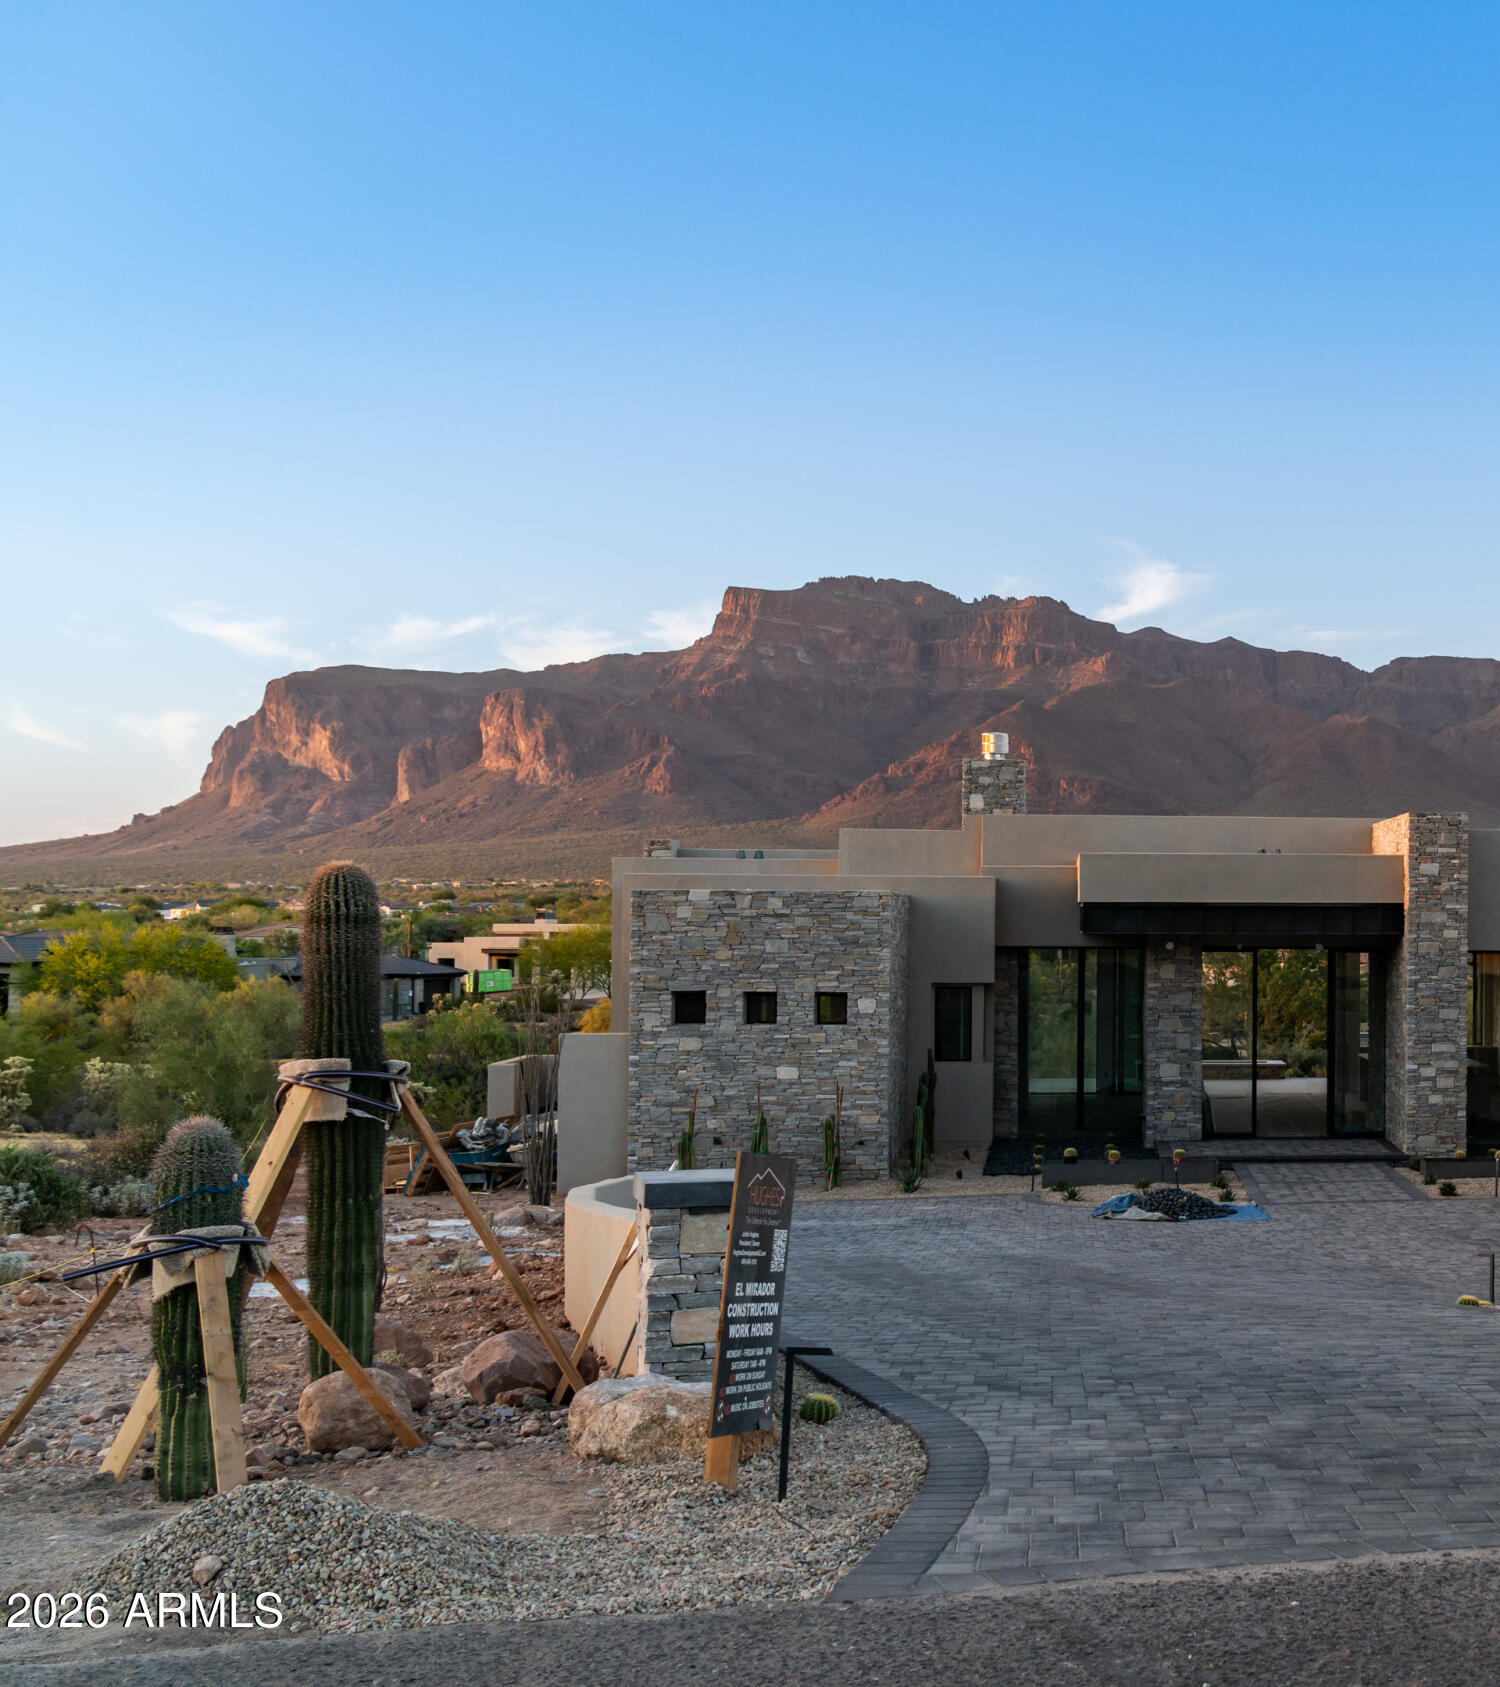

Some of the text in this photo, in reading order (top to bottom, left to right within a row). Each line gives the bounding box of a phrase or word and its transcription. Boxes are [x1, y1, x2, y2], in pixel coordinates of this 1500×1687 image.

[750, 1184, 780, 1206] HUGHES
[735, 1282, 776, 1296] EL MIRADOR
[727, 1302, 779, 1318] CONSTRUCTION
[729, 1322, 774, 1338] WORK HOURS
[726, 1349, 742, 1358] MONDAY
[744, 1348, 757, 1357] FRIDAY
[731, 1360, 750, 1370] SATURDAY
[735, 1372, 747, 1382] WORK
[752, 1370, 767, 1380] SUNDAY
[725, 1385, 737, 1395] WORK
[743, 1382, 756, 1392] PUBLIC
[756, 1381, 772, 1391] HOLIDAYS
[730, 1402, 742, 1412] MUSIC
